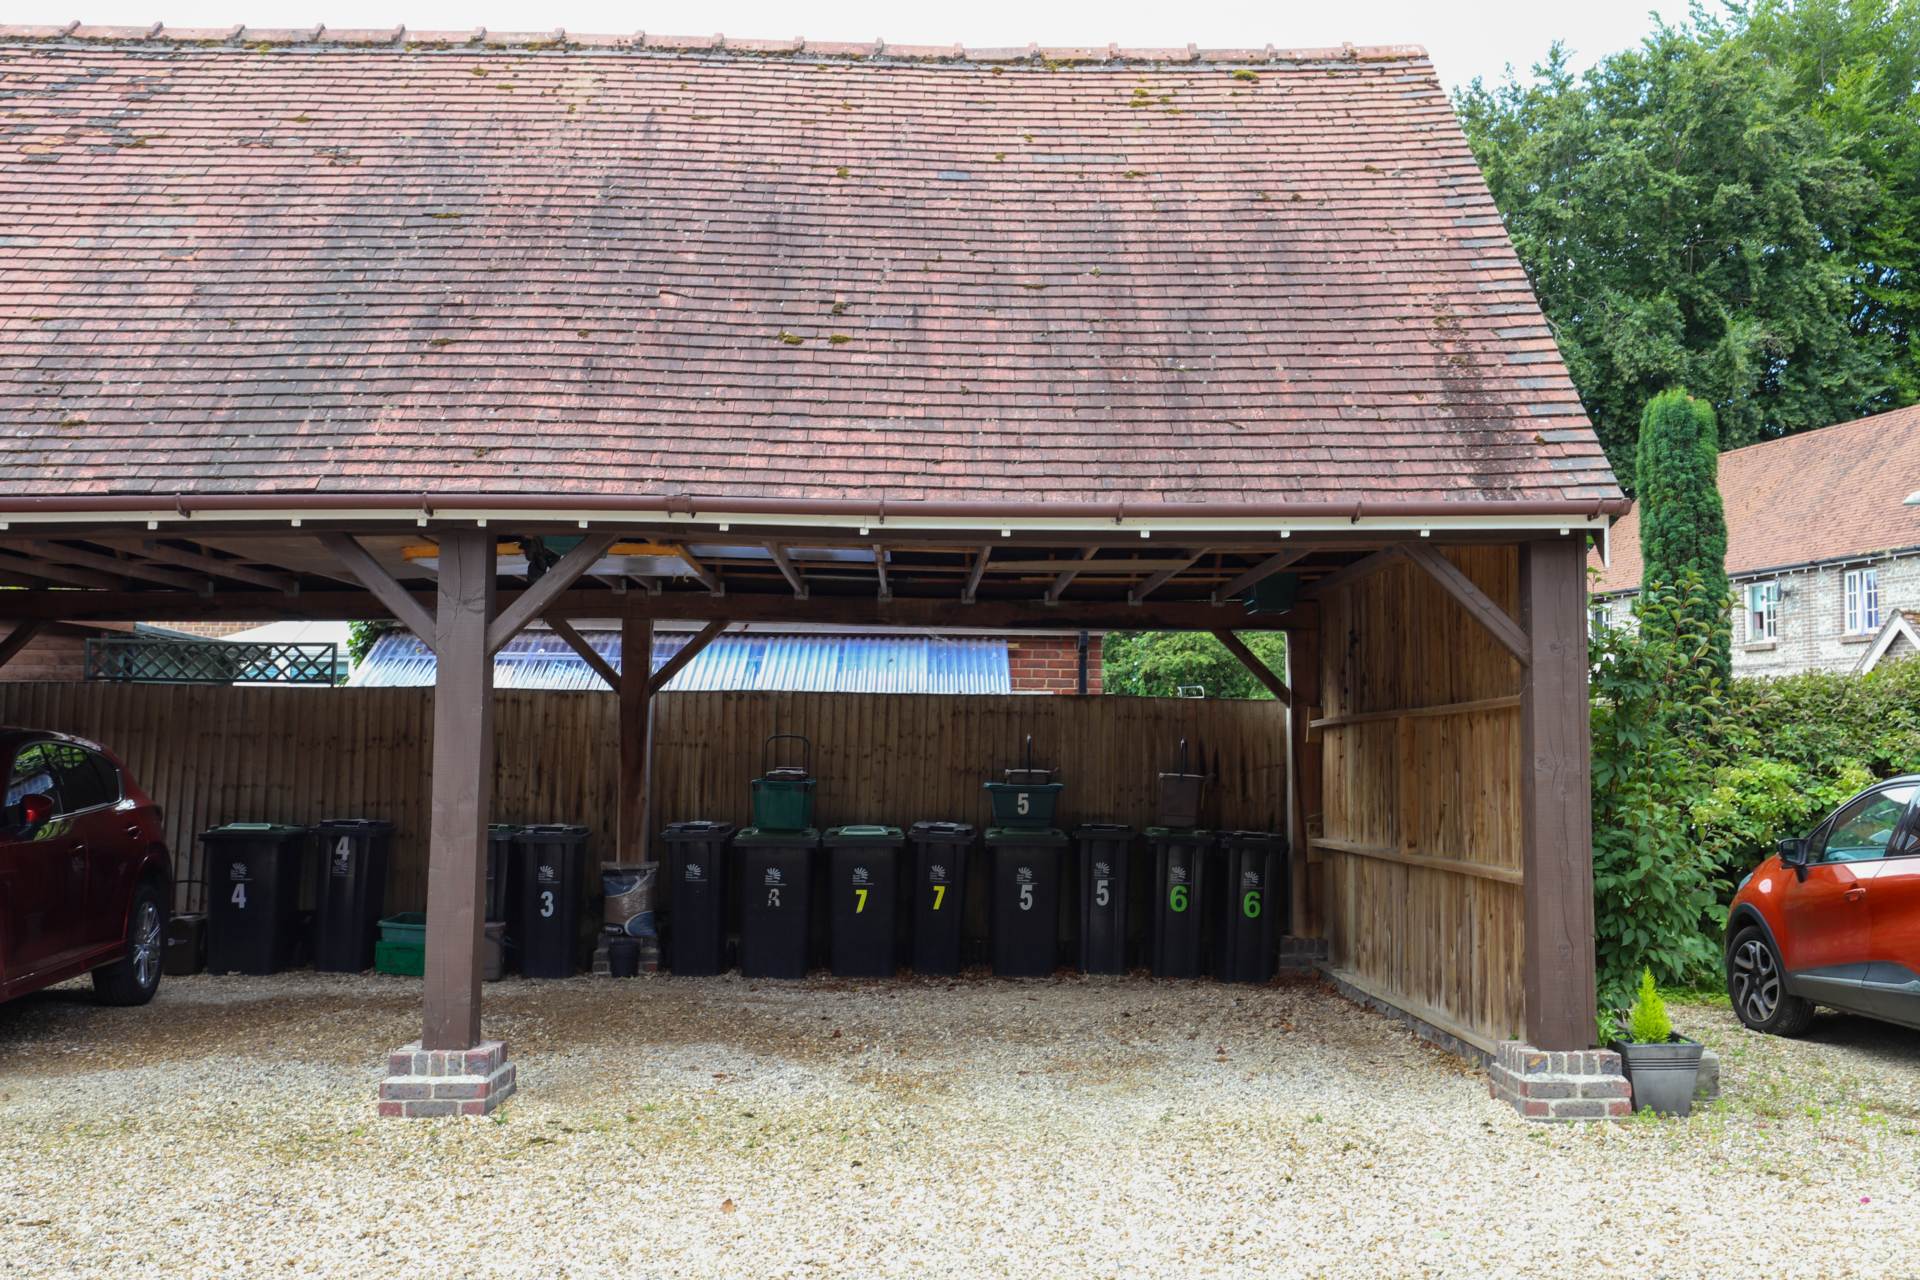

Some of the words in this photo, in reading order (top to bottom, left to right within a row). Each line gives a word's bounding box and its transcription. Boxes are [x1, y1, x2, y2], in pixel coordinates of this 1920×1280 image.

[1017, 792, 1030, 815] 5
[335, 836, 350, 861] 4
[231, 883, 247, 909] 4
[540, 890, 554, 918] 3
[855, 889, 868, 914] 7
[933, 885, 946, 911] 7
[1019, 884, 1033, 911] 5
[1095, 880, 1110, 906] 5
[1169, 885, 1189, 912] 6
[1243, 891, 1261, 918] 6
